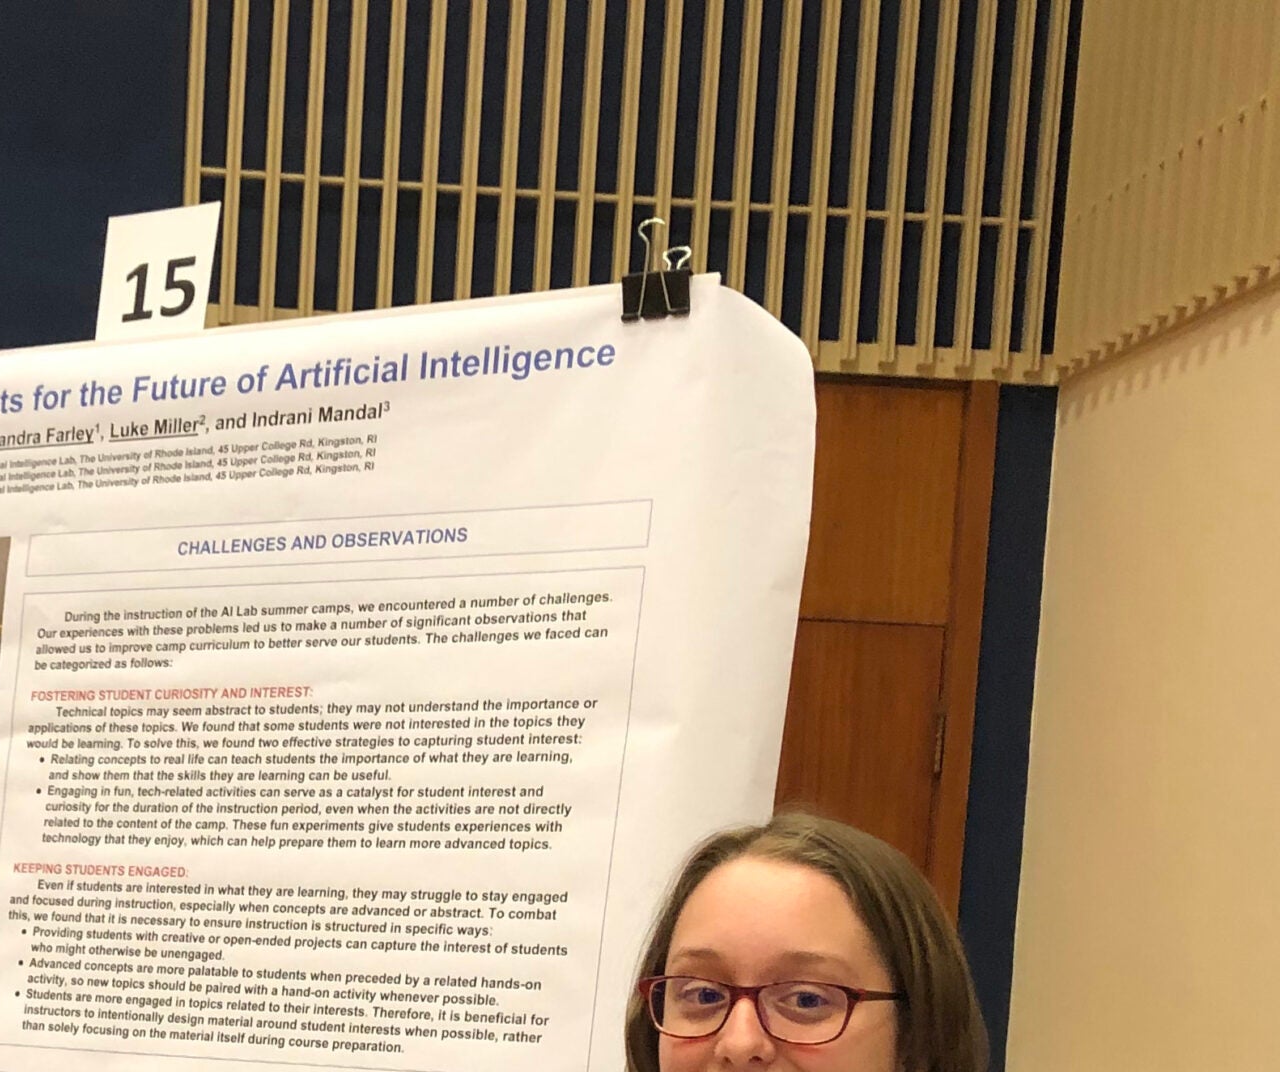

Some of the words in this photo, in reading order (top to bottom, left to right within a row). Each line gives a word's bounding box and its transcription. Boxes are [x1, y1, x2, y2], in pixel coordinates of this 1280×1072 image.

[121, 256, 196, 323] 15
[33, 384, 72, 411] for
[79, 380, 123, 407] the
[132, 374, 226, 402] Future
[236, 364, 269, 394] of
[274, 353, 408, 391] Artificial
[420, 344, 615, 380] Intelligence
[110, 420, 149, 438] Luke
[215, 412, 247, 430] and
[252, 407, 312, 428] Indrani
[177, 536, 287, 556] CHALLENGES
[290, 534, 327, 550] AND
[331, 527, 468, 548] OBSERVATIONS
[64, 610, 101, 624] During
[103, 609, 121, 621] the
[123, 607, 183, 620] instruction
[185, 606, 198, 619] of
[200, 606, 218, 618] the
[220, 605, 233, 617] AI
[236, 605, 258, 617] Lab
[260, 605, 309, 616] summer
[311, 603, 354, 616] camps,
[357, 603, 375, 612] we
[377, 597, 456, 612] encountered
[458, 599, 466, 609] a
[470, 595, 519, 608] number
[522, 593, 536, 606] of
[538, 592, 612, 606] challenges.
[30, 689, 96, 701] FOSTERING
[98, 688, 152, 701] STUDENT
[154, 687, 219, 701] CURIOSITY
[220, 687, 247, 699] AND
[249, 685, 313, 698] INTEREST:
[13, 862, 62, 875] KEEPING
[64, 863, 125, 877] STUDENTS
[127, 865, 188, 878] ENGAGED:
[30, 941, 53, 953] who
[55, 942, 86, 957] might
[88, 944, 141, 957] otherwise
[143, 946, 158, 958] be
[160, 949, 224, 963] unengaged.
[26, 973, 67, 988] activity,
[70, 977, 84, 986] so
[86, 978, 109, 987] new
[111, 977, 145, 991] topics
[148, 979, 186, 991] should
[188, 980, 203, 992] be
[204, 982, 241, 995] paired
[244, 983, 268, 995] with
[270, 987, 278, 996] a
[281, 984, 330, 998] hand-on
[332, 988, 377, 1003] activity
[379, 990, 440, 1003] whenever
[441, 993, 499, 1006] possible.
